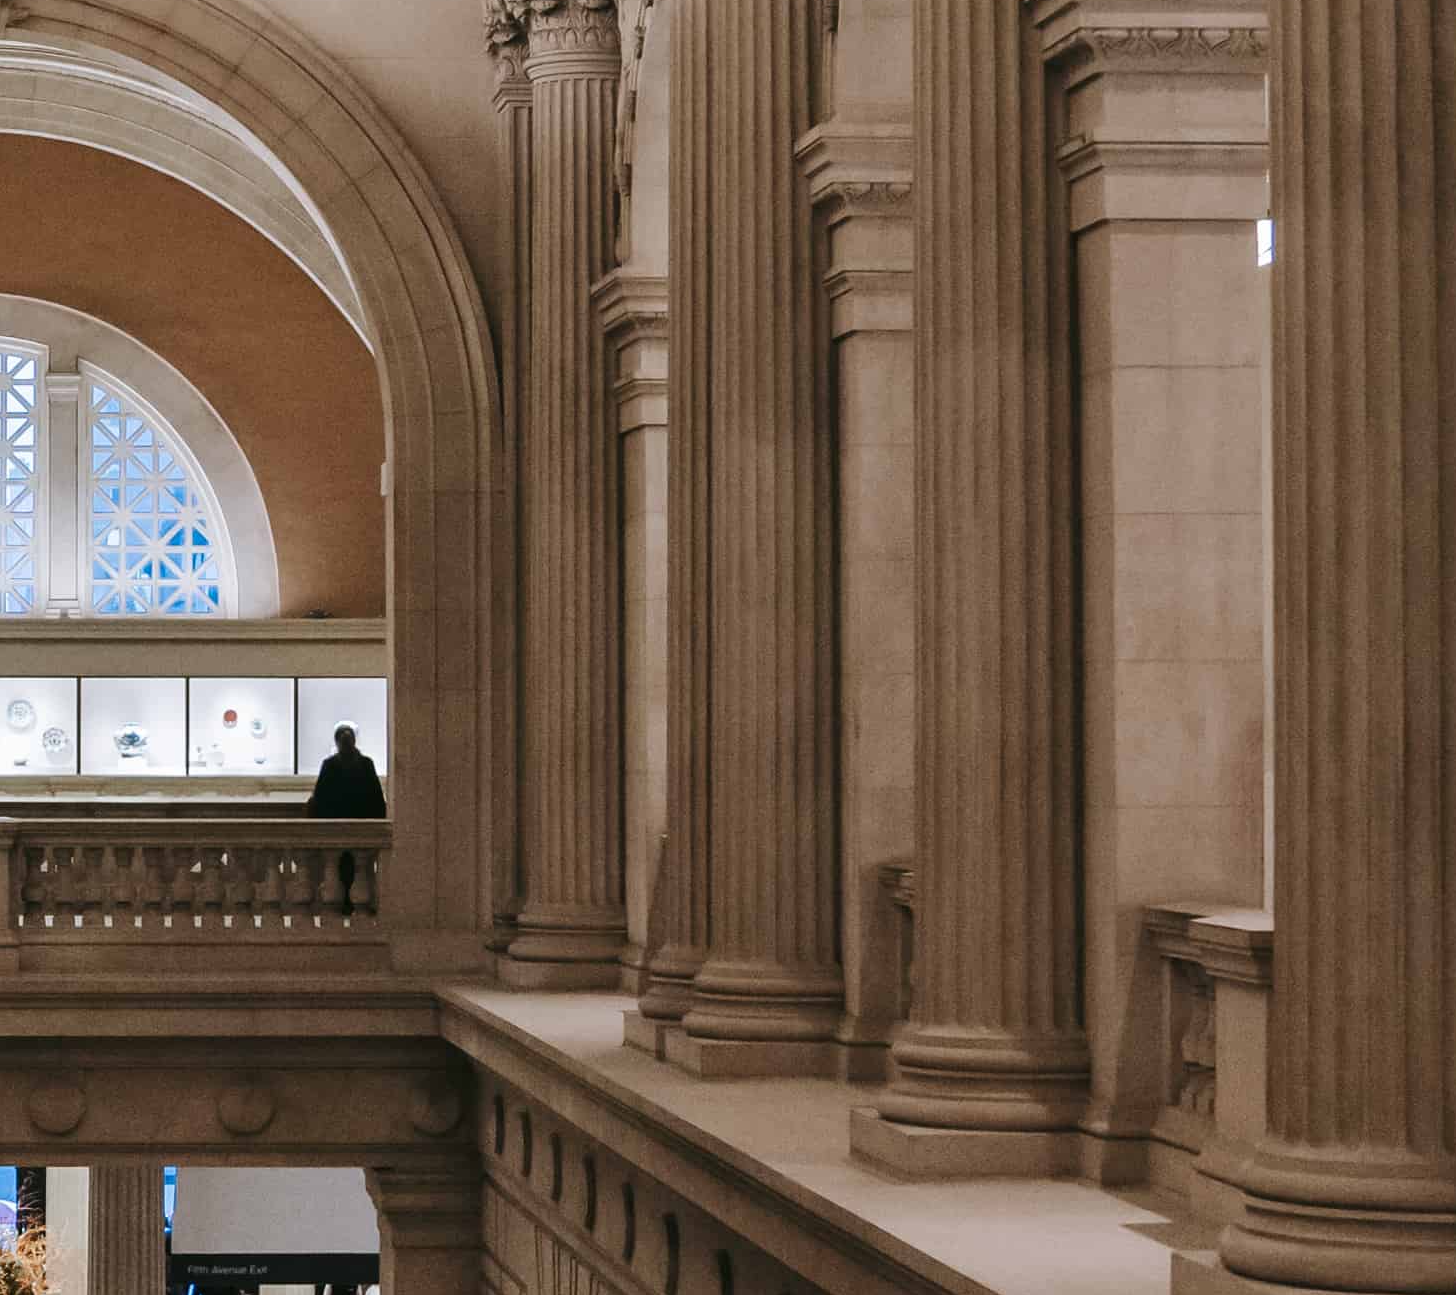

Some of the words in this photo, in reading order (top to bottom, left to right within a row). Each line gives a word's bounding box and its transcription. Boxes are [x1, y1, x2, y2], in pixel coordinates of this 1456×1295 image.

[187, 1264, 208, 1274] Fifth
[211, 1264, 247, 1274] Avenue
[249, 1264, 268, 1274] Exit
